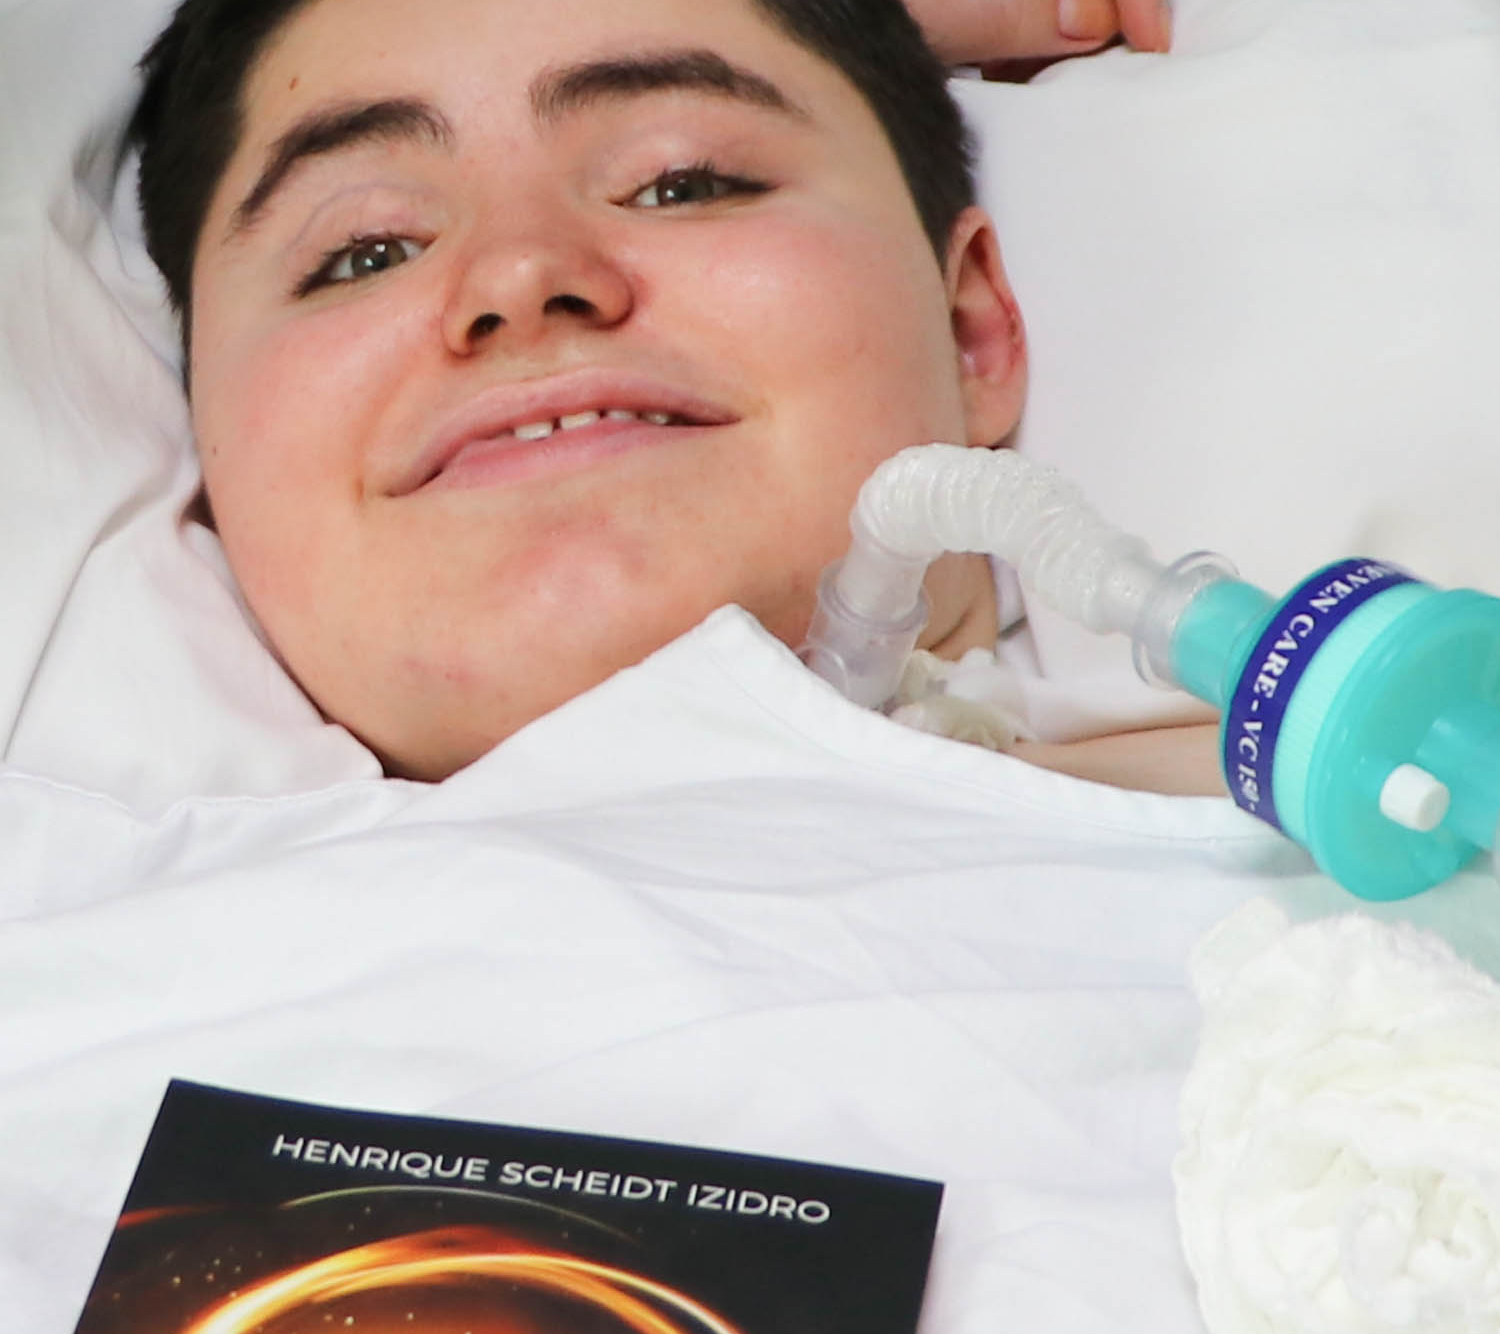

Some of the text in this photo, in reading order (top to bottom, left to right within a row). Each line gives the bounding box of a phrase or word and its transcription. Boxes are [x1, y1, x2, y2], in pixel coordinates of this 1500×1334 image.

[1253, 613, 1315, 699] CARE
[1239, 721, 1263, 763] VC
[271, 1133, 831, 1225] HENRIQUE SCHEIDT IZIDRO
